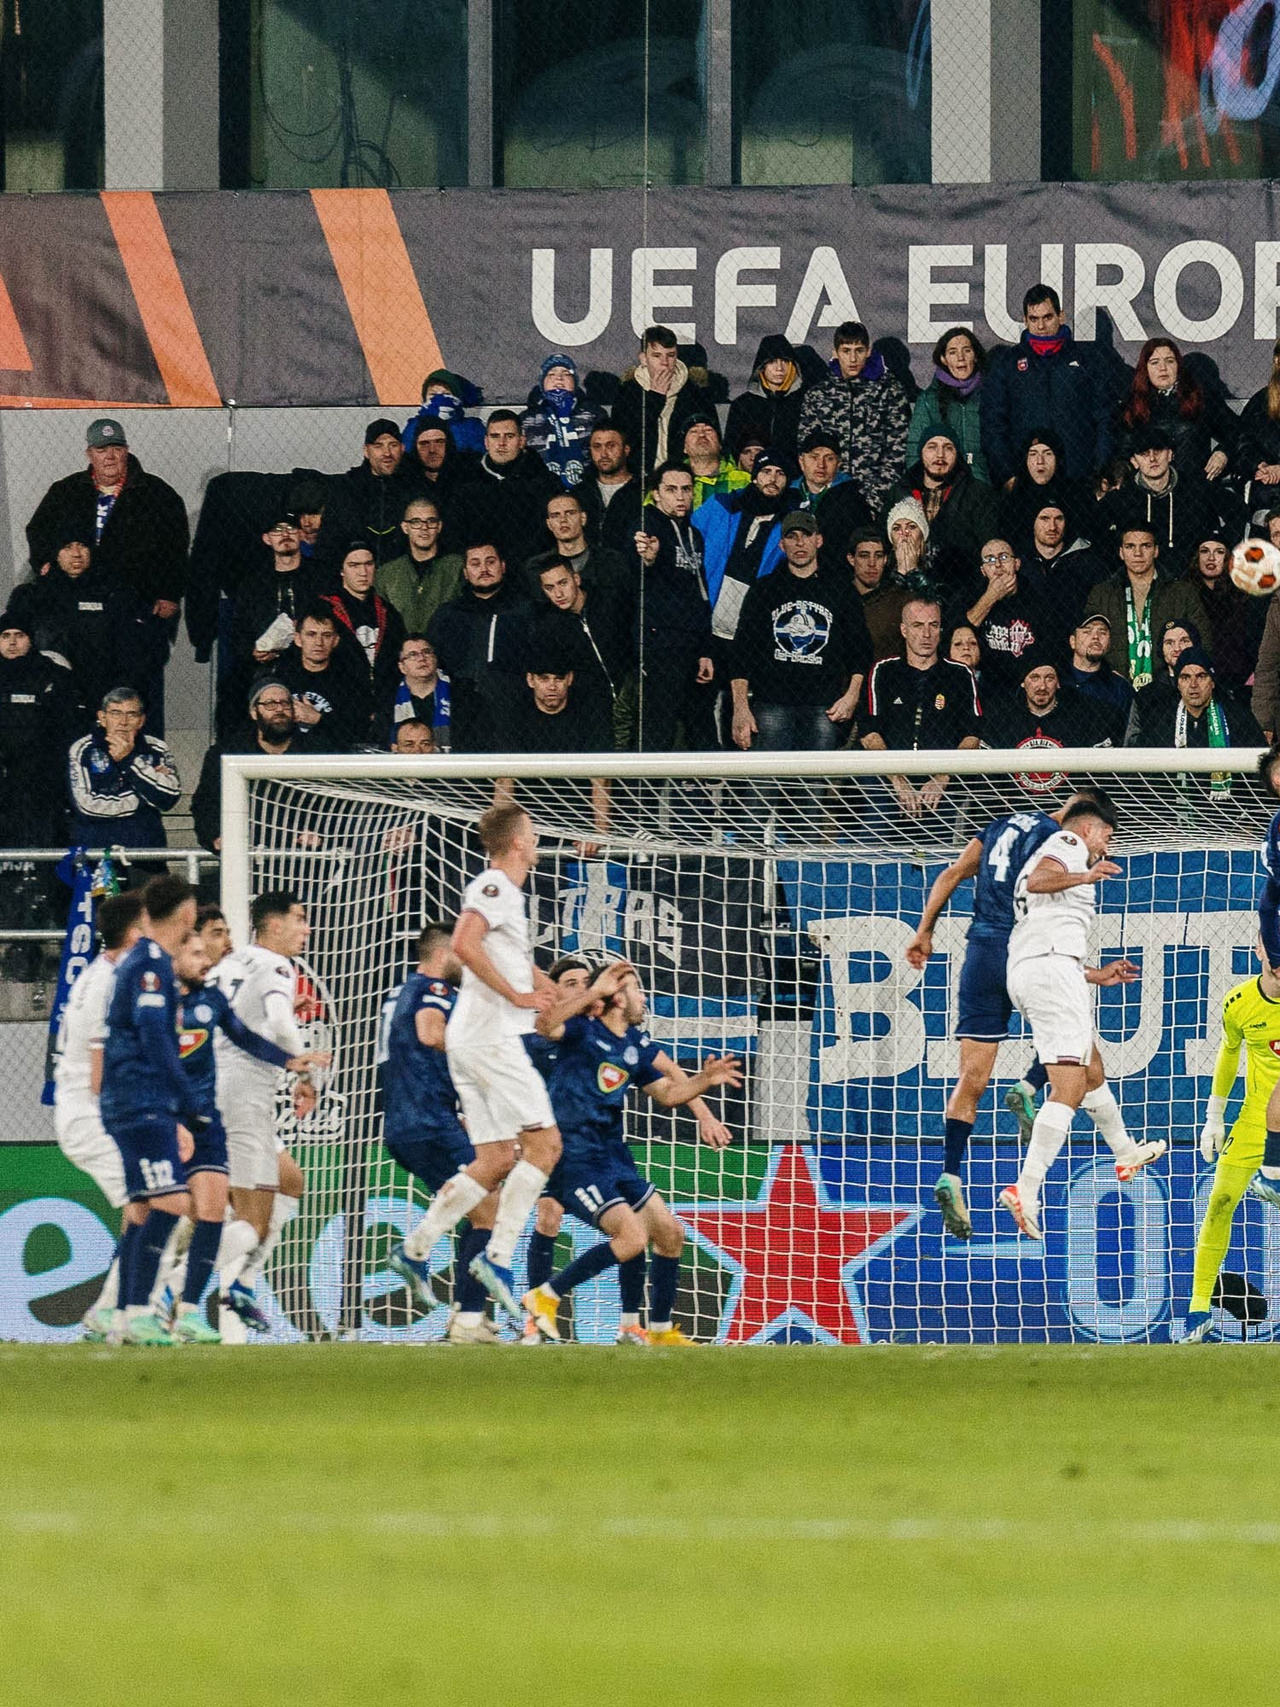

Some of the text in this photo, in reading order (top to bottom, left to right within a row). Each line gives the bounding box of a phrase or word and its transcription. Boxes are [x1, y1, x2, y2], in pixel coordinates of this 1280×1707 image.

[531, 246, 861, 347] UEFA
[988, 826, 1020, 882] 4
[529, 884, 683, 968] LTRAS
